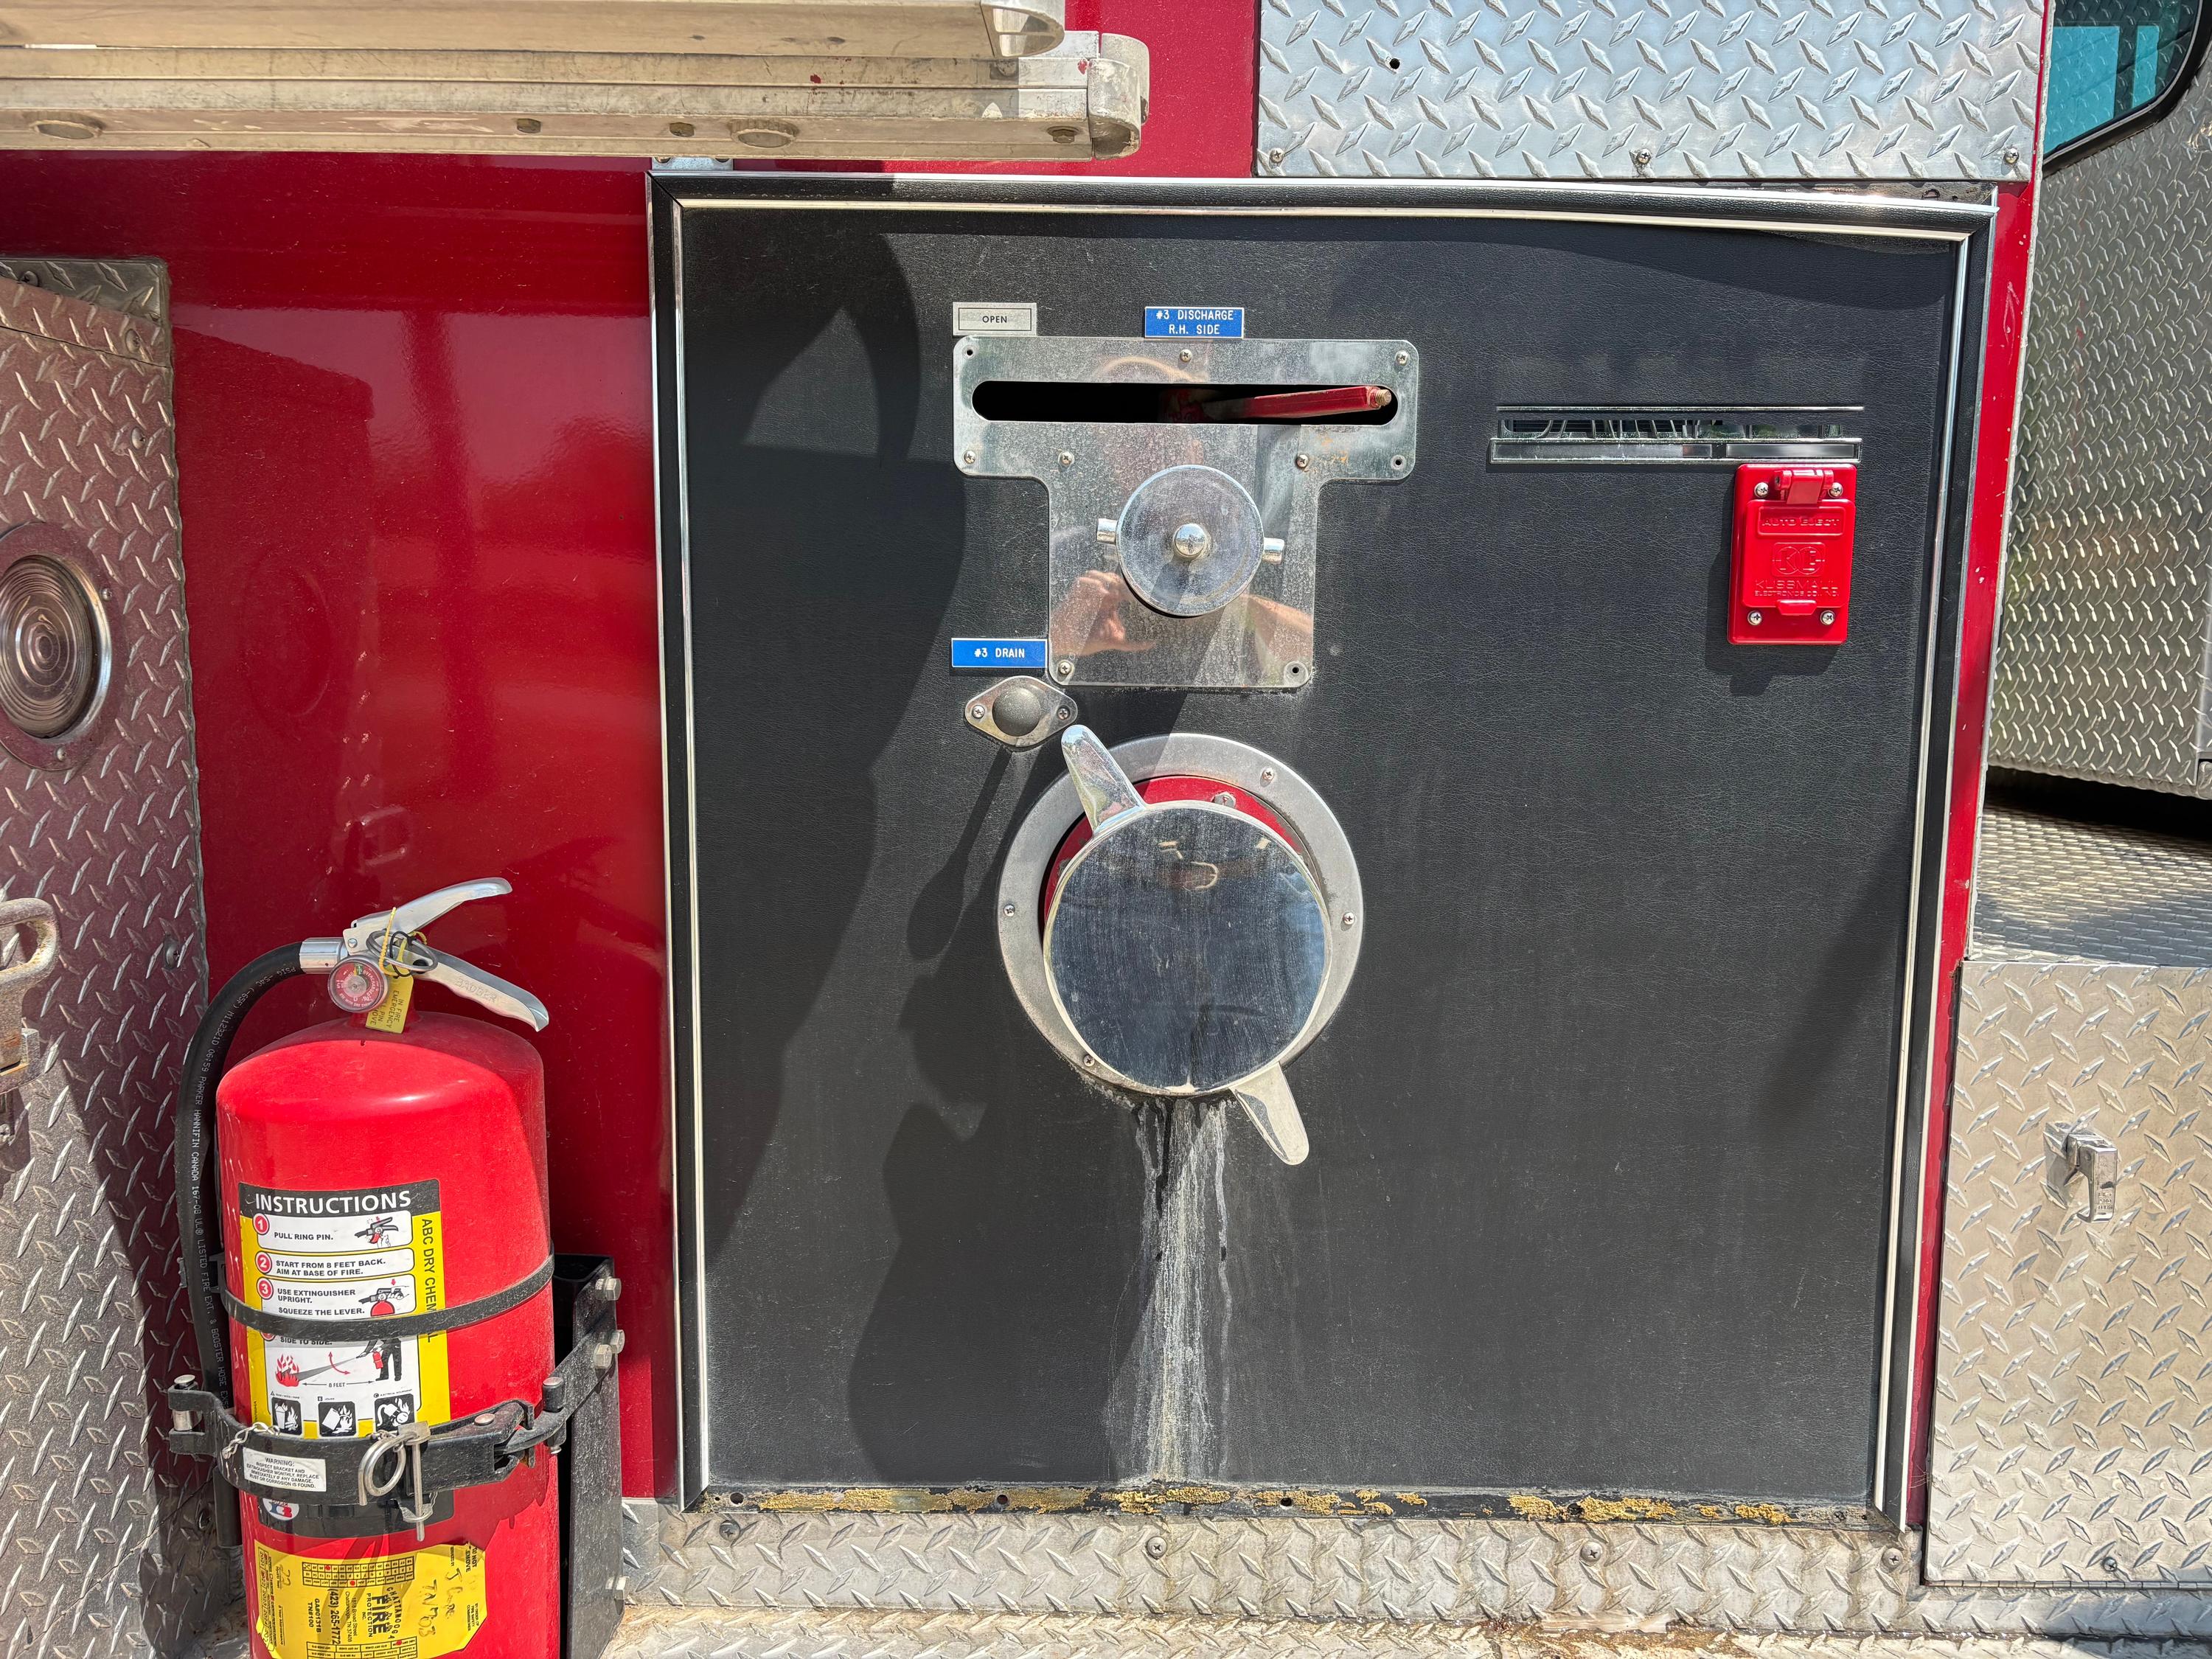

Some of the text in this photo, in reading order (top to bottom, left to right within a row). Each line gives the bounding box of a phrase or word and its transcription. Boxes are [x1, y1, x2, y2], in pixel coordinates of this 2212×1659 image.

[982, 315, 1007, 324] OPEN
[1155, 309, 1234, 321] #3 DISCHARGE
[1169, 324, 1220, 335] R.H. SIDE
[1762, 517, 1840, 526] AUTO EJECT
[1754, 580, 1839, 590] KUSSMAUL
[974, 647, 1025, 658] #3 DRAIN
[276, 966, 296, 976] PSIG
[233, 987, 254, 1009] (-65F)
[385, 990, 400, 1029] EMERGENCY
[393, 1008, 403, 1023] FIRE
[378, 1011, 386, 1023] PIN
[201, 1048, 215, 1072] 06:59
[195, 1076, 207, 1105] PARKER
[191, 1109, 202, 1148] HANNIFIN
[191, 1152, 200, 1181] CANADA
[192, 1186, 202, 1215] 167-08
[255, 1190, 411, 1214] INSTRUCTIONS
[258, 1219, 264, 1230] 1
[274, 1231, 293, 1239] PULL
[422, 1218, 434, 1245] ABC
[197, 1239, 207, 1268] LISTED
[260, 1256, 268, 1267] 2
[276, 1259, 299, 1268] START
[334, 1260, 356, 1268] FEET
[358, 1258, 386, 1266] BACK.
[423, 1248, 435, 1274] DRY
[201, 1272, 211, 1293] FIRE
[262, 1284, 269, 1294] 3
[278, 1287, 355, 1296] USE EXTINGUISHER
[204, 1295, 214, 1315] EXT.
[277, 1295, 313, 1304] UPRIGHT.
[278, 1307, 313, 1315] SQUEEZE
[334, 1307, 365, 1315] LEVER.
[211, 1328, 224, 1363] BOOSTER
[218, 1366, 228, 1386] HOSE
[256, 1461, 273, 1470] INSPECT
[265, 1457, 295, 1467] WARNING:
[246, 1463, 274, 1474] EXTINGUISHER
[251, 1469, 276, 1479] IMMEDIATELY
[265, 1478, 291, 1486] CORROSION
[307, 1601, 315, 1628] TN#100
[328, 1587, 341, 1645] (423) 265-1772
[371, 1593, 393, 1635] FIRE
[386, 1586, 403, 1640] CHATTANOOGA
